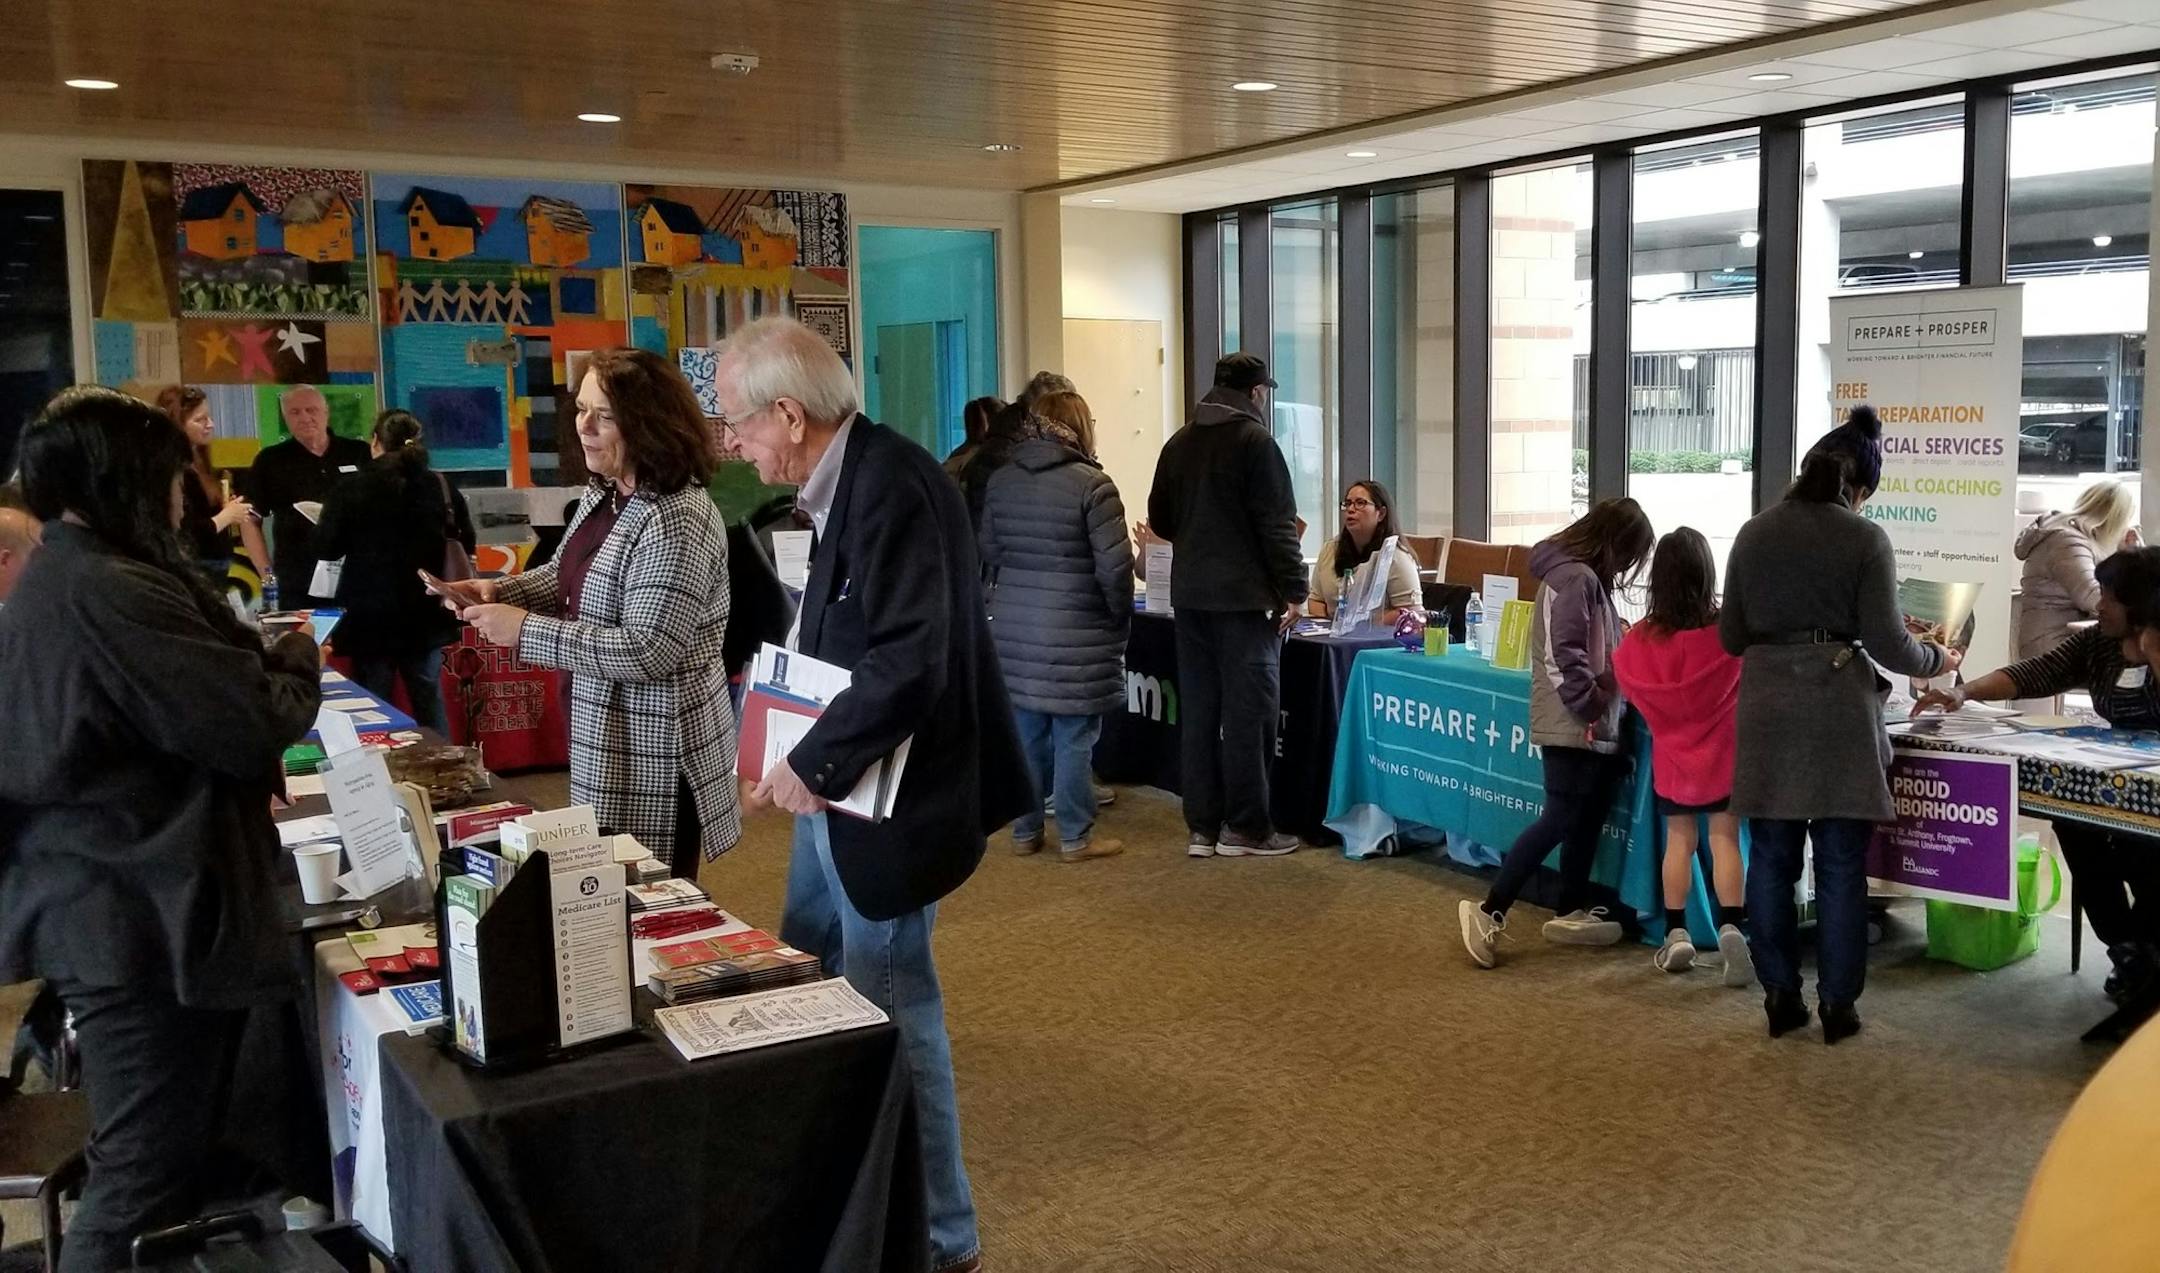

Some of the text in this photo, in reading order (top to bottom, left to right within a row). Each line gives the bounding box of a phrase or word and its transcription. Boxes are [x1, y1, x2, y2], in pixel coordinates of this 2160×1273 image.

[1854, 325, 1911, 340] PREPARE
[1928, 321, 1988, 336] PROSPER
[1835, 382, 1868, 399] FREE
[1835, 405, 1984, 424] TA REPARATION
[1880, 437, 2004, 456] CIAL SERVICES
[1879, 474, 2002, 497] CIAL COACHING
[1864, 504, 1938, 523] BANKING
[1894, 547, 1915, 557] nteer
[1923, 549, 1939, 558] staff
[1941, 551, 2000, 564] opportunities!
[1373, 692, 1477, 743] PREPARE
[1927, 768, 1940, 778] the
[1412, 766, 1459, 790] TOWARD
[1462, 781, 1469, 794] A
[1469, 784, 1523, 812] BRIGHTER
[1893, 776, 1951, 800] PROUD
[1893, 796, 1999, 827] HBORHOODS
[586, 843, 602, 851] Care
[1920, 839, 1957, 856] University
[1936, 831, 1974, 847] Frogtown,
[551, 849, 608, 864] hoices Navigator
[582, 882, 597, 894] 10
[557, 902, 602, 917] Medicare
[604, 896, 622, 907] List
